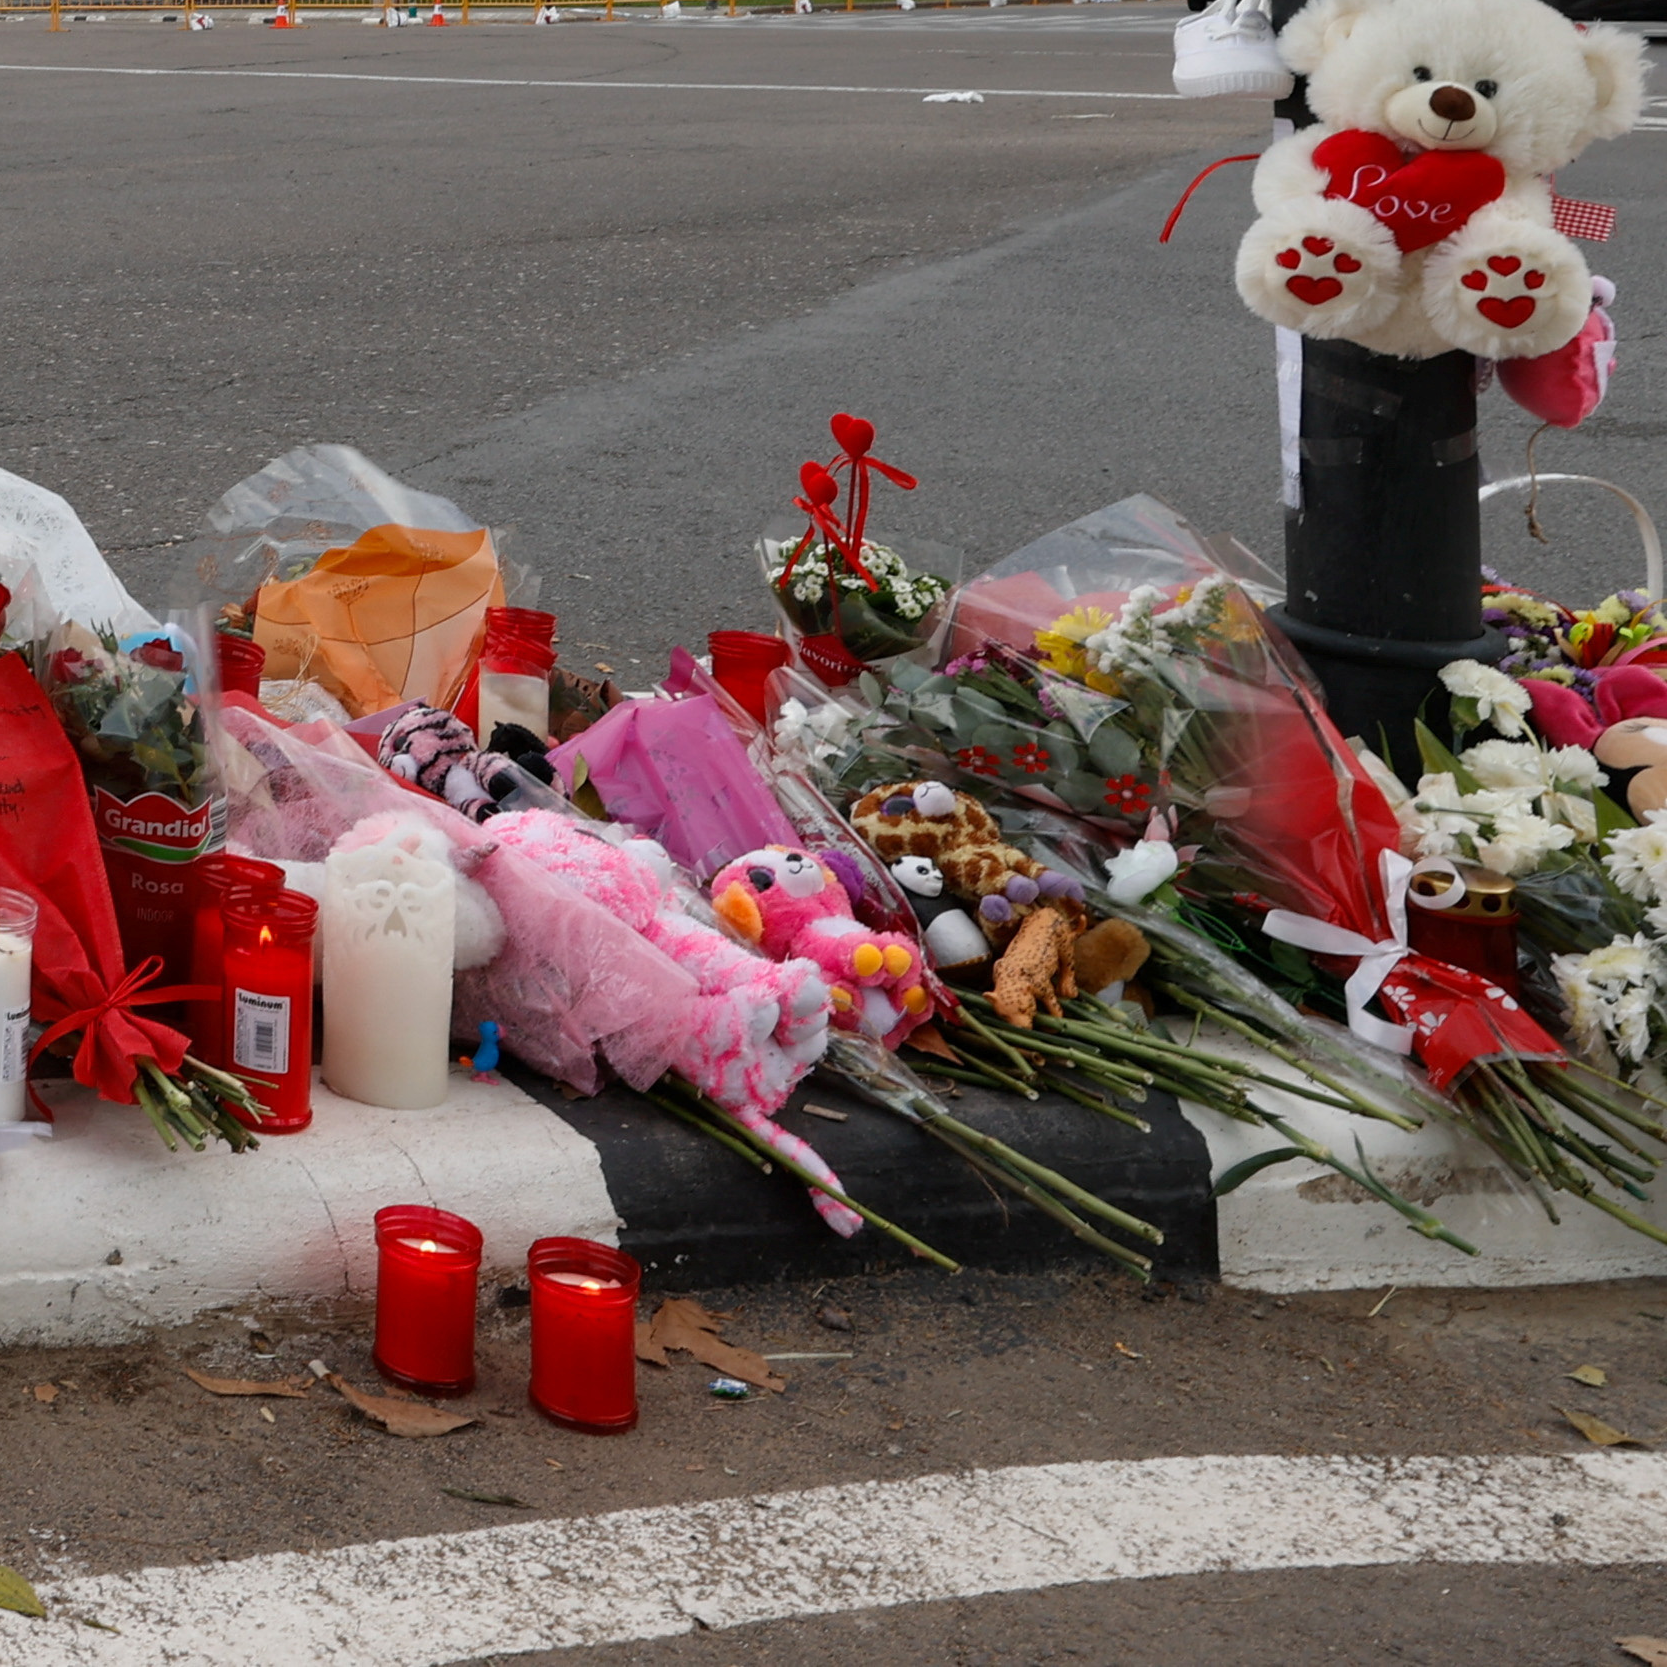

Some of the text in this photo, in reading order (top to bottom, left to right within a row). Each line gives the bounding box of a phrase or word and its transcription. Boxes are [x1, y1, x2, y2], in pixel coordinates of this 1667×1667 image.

[1326, 164, 1456, 224] Love
[105, 808, 207, 838] Grandiol
[131, 872, 184, 894] Rosa
[136, 906, 175, 923] INDOOR
